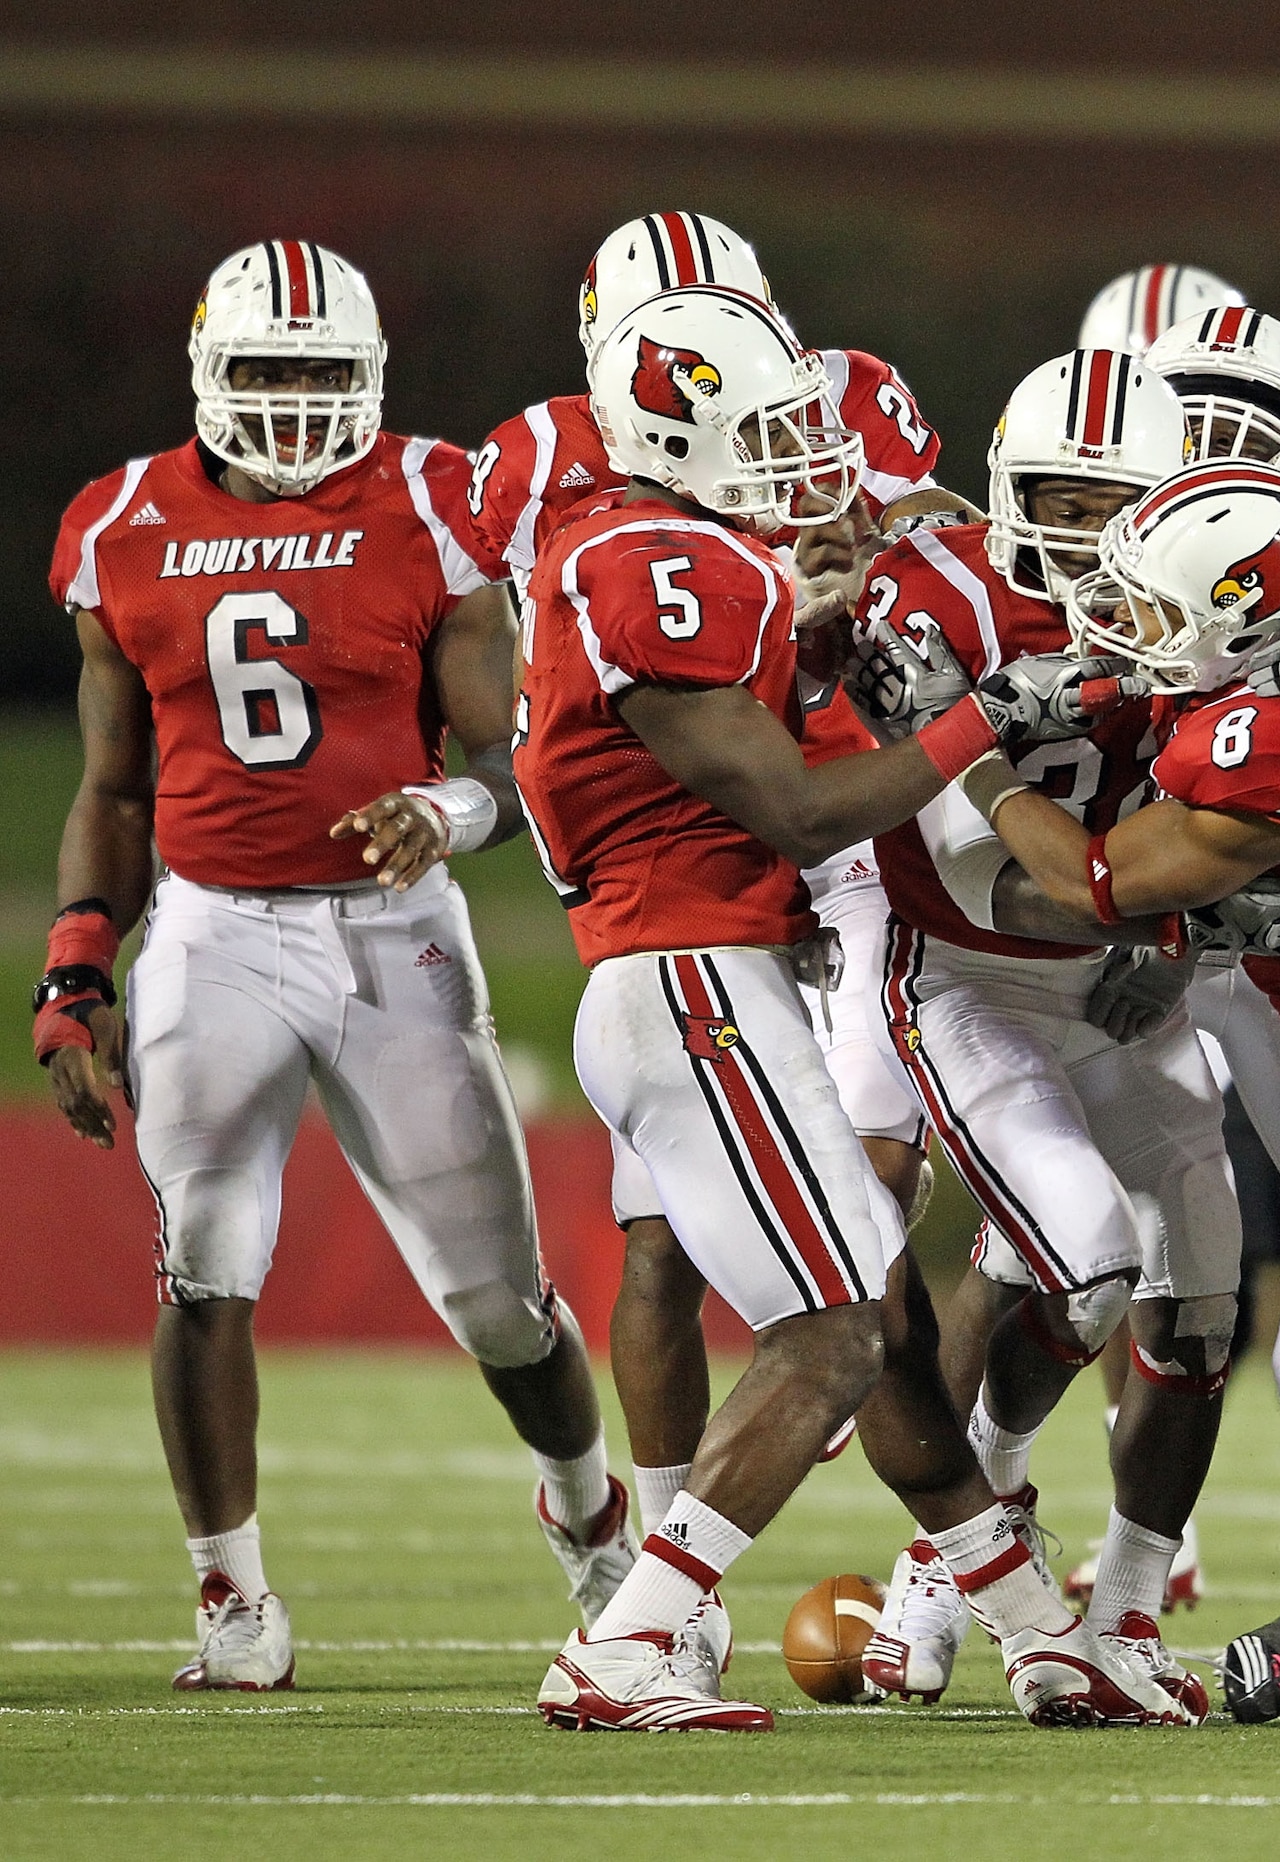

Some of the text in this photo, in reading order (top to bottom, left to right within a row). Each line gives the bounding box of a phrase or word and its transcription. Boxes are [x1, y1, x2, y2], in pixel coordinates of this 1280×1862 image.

[559, 476, 595, 488] adidas
[129, 516, 167, 526] adidas
[156, 530, 364, 580] LOUISVILLE
[648, 554, 702, 641] 5
[204, 590, 324, 773] 6
[1211, 706, 1258, 772] 8
[841, 871, 880, 883] adidas
[661, 1524, 691, 1550] adidas
